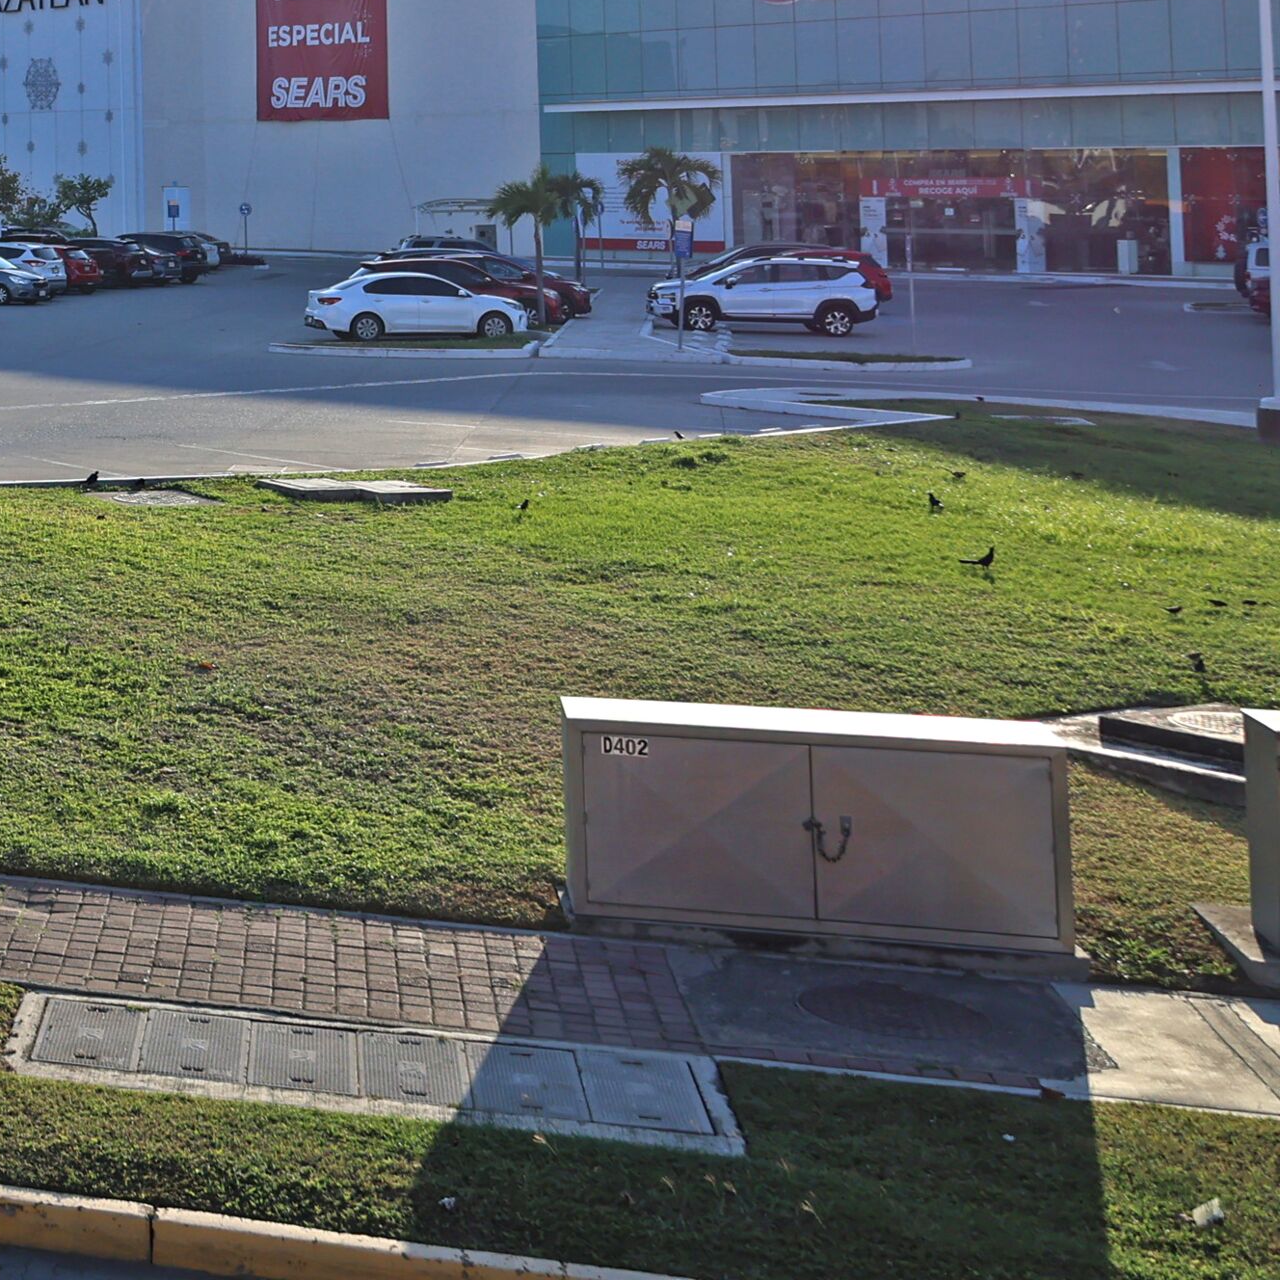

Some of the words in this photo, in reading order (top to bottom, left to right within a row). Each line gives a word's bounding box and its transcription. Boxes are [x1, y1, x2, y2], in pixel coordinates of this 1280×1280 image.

[267, 21, 371, 48] ESPECIAL
[270, 74, 367, 109] SEARS
[636, 240, 666, 250] SEARS
[603, 736, 649, 756] D402
